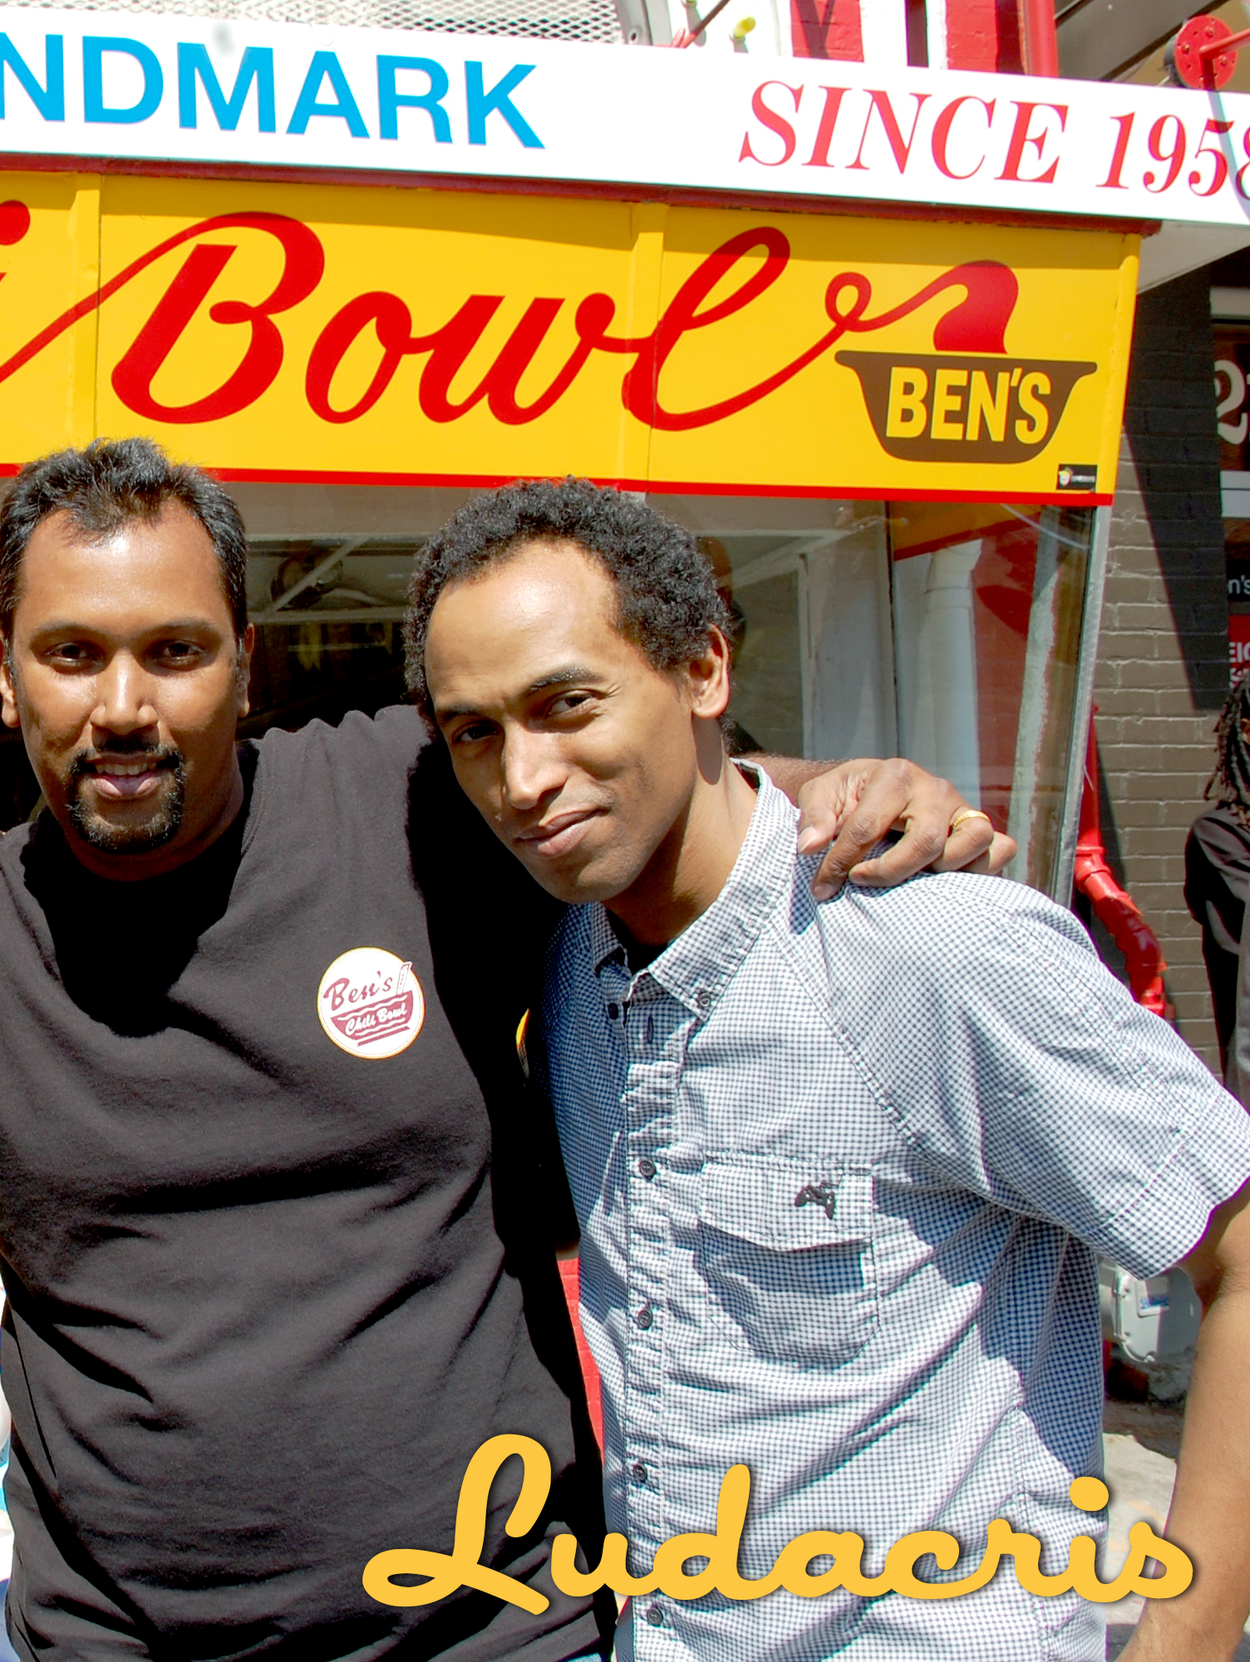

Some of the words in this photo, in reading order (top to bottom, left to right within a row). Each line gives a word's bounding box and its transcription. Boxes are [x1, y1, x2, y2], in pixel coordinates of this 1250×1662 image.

[738, 79, 1070, 182] SINCE
[110, 210, 828, 431] Bowl
[885, 365, 1052, 444] BEN'S
[323, 970, 393, 1011] Ben's
[345, 1013, 377, 1036] Chili
[376, 1002, 407, 1023] Bowl
